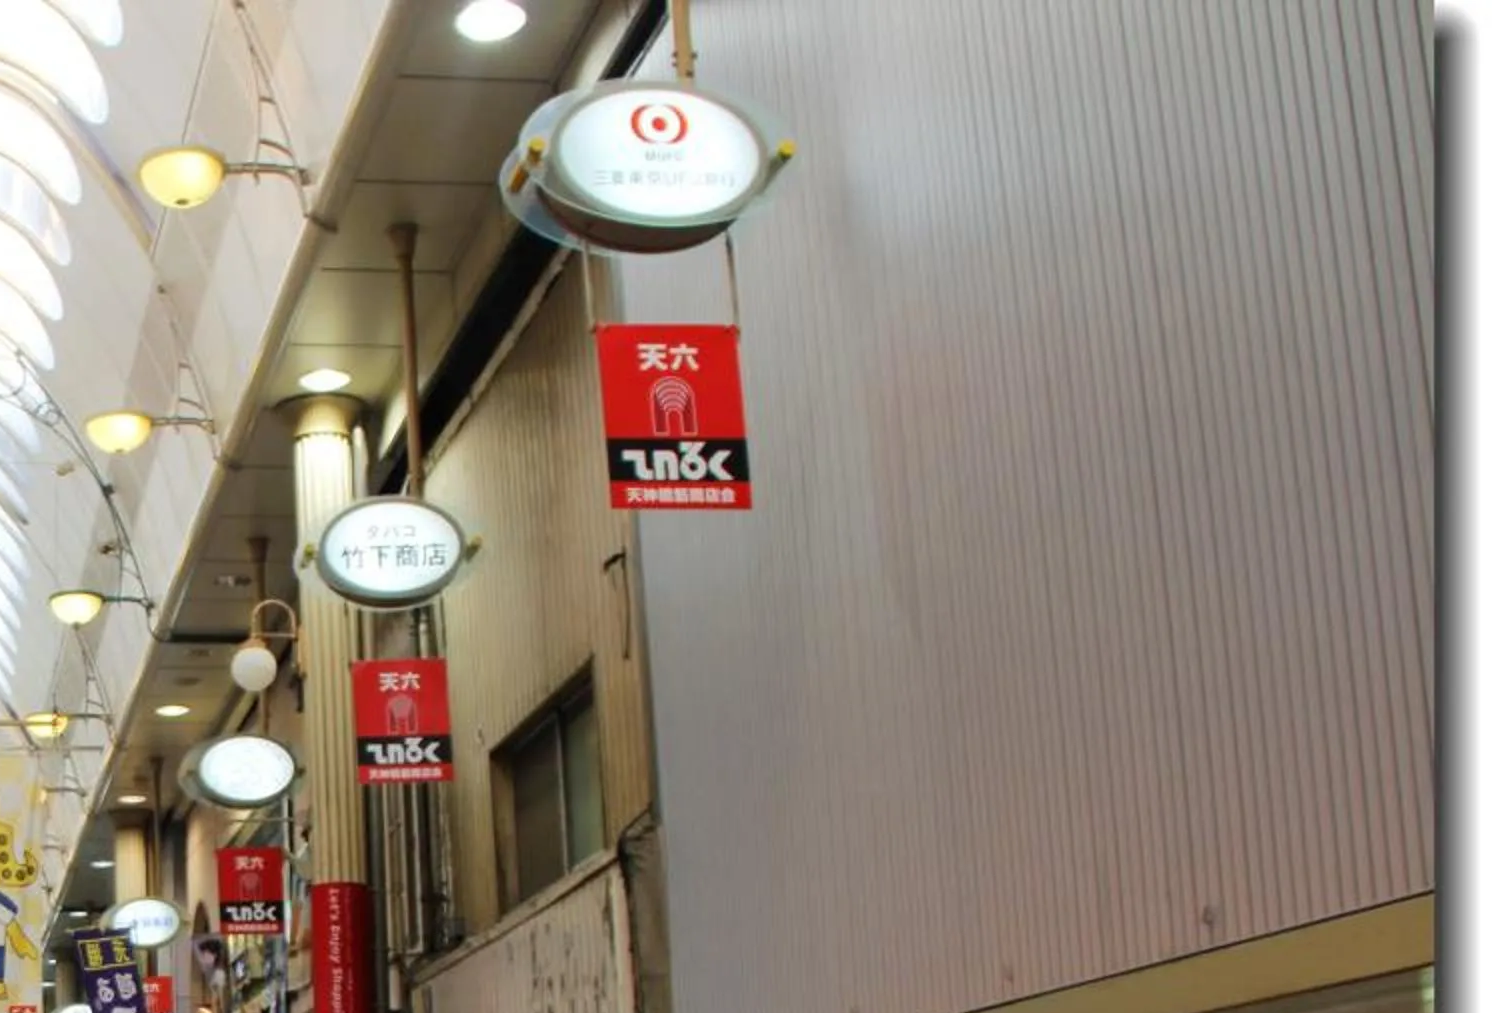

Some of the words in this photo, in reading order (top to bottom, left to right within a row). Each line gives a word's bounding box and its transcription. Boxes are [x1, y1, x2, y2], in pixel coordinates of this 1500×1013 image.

[637, 343, 699, 371] 天六
[341, 543, 447, 568] 竹下商店
[379, 672, 421, 691] 天六
